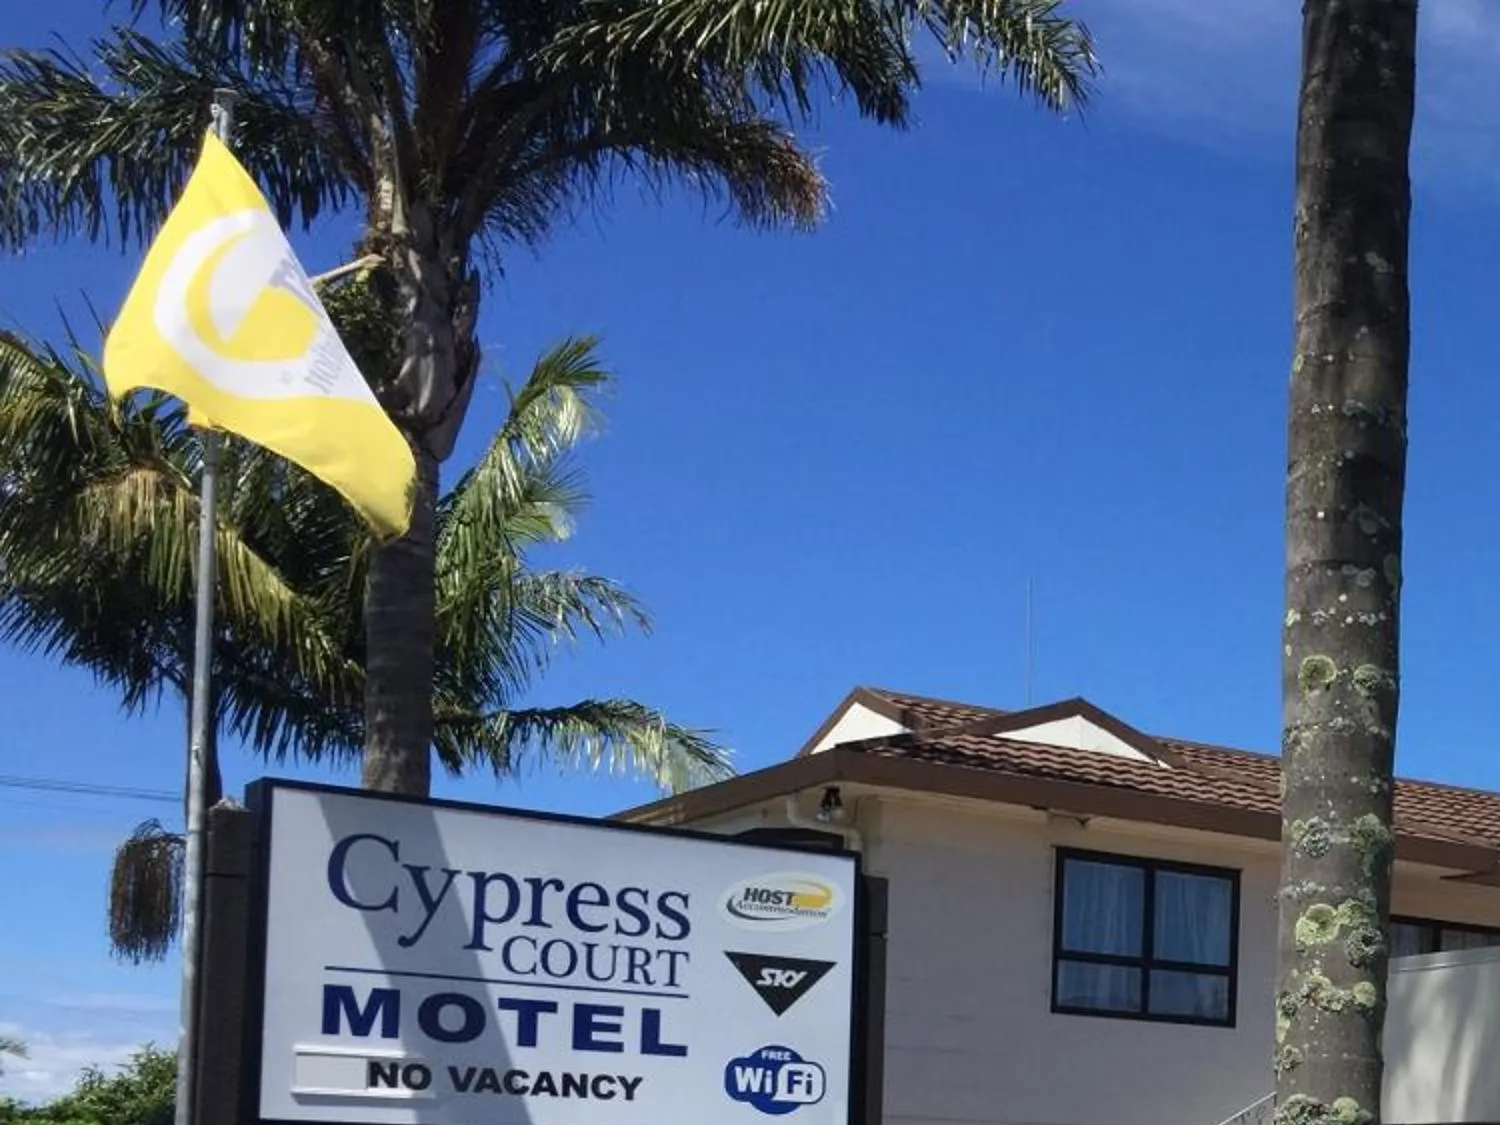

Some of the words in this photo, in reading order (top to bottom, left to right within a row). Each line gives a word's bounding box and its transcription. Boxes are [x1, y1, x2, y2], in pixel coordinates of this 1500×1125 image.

[327, 834, 691, 951] Cypress
[743, 887, 795, 906] HOST
[502, 935, 690, 987] COURT
[321, 984, 688, 1057] MOTEL
[761, 1050, 792, 1061] FREE
[368, 1059, 432, 1091] NO
[448, 1065, 644, 1101] VACANCY
